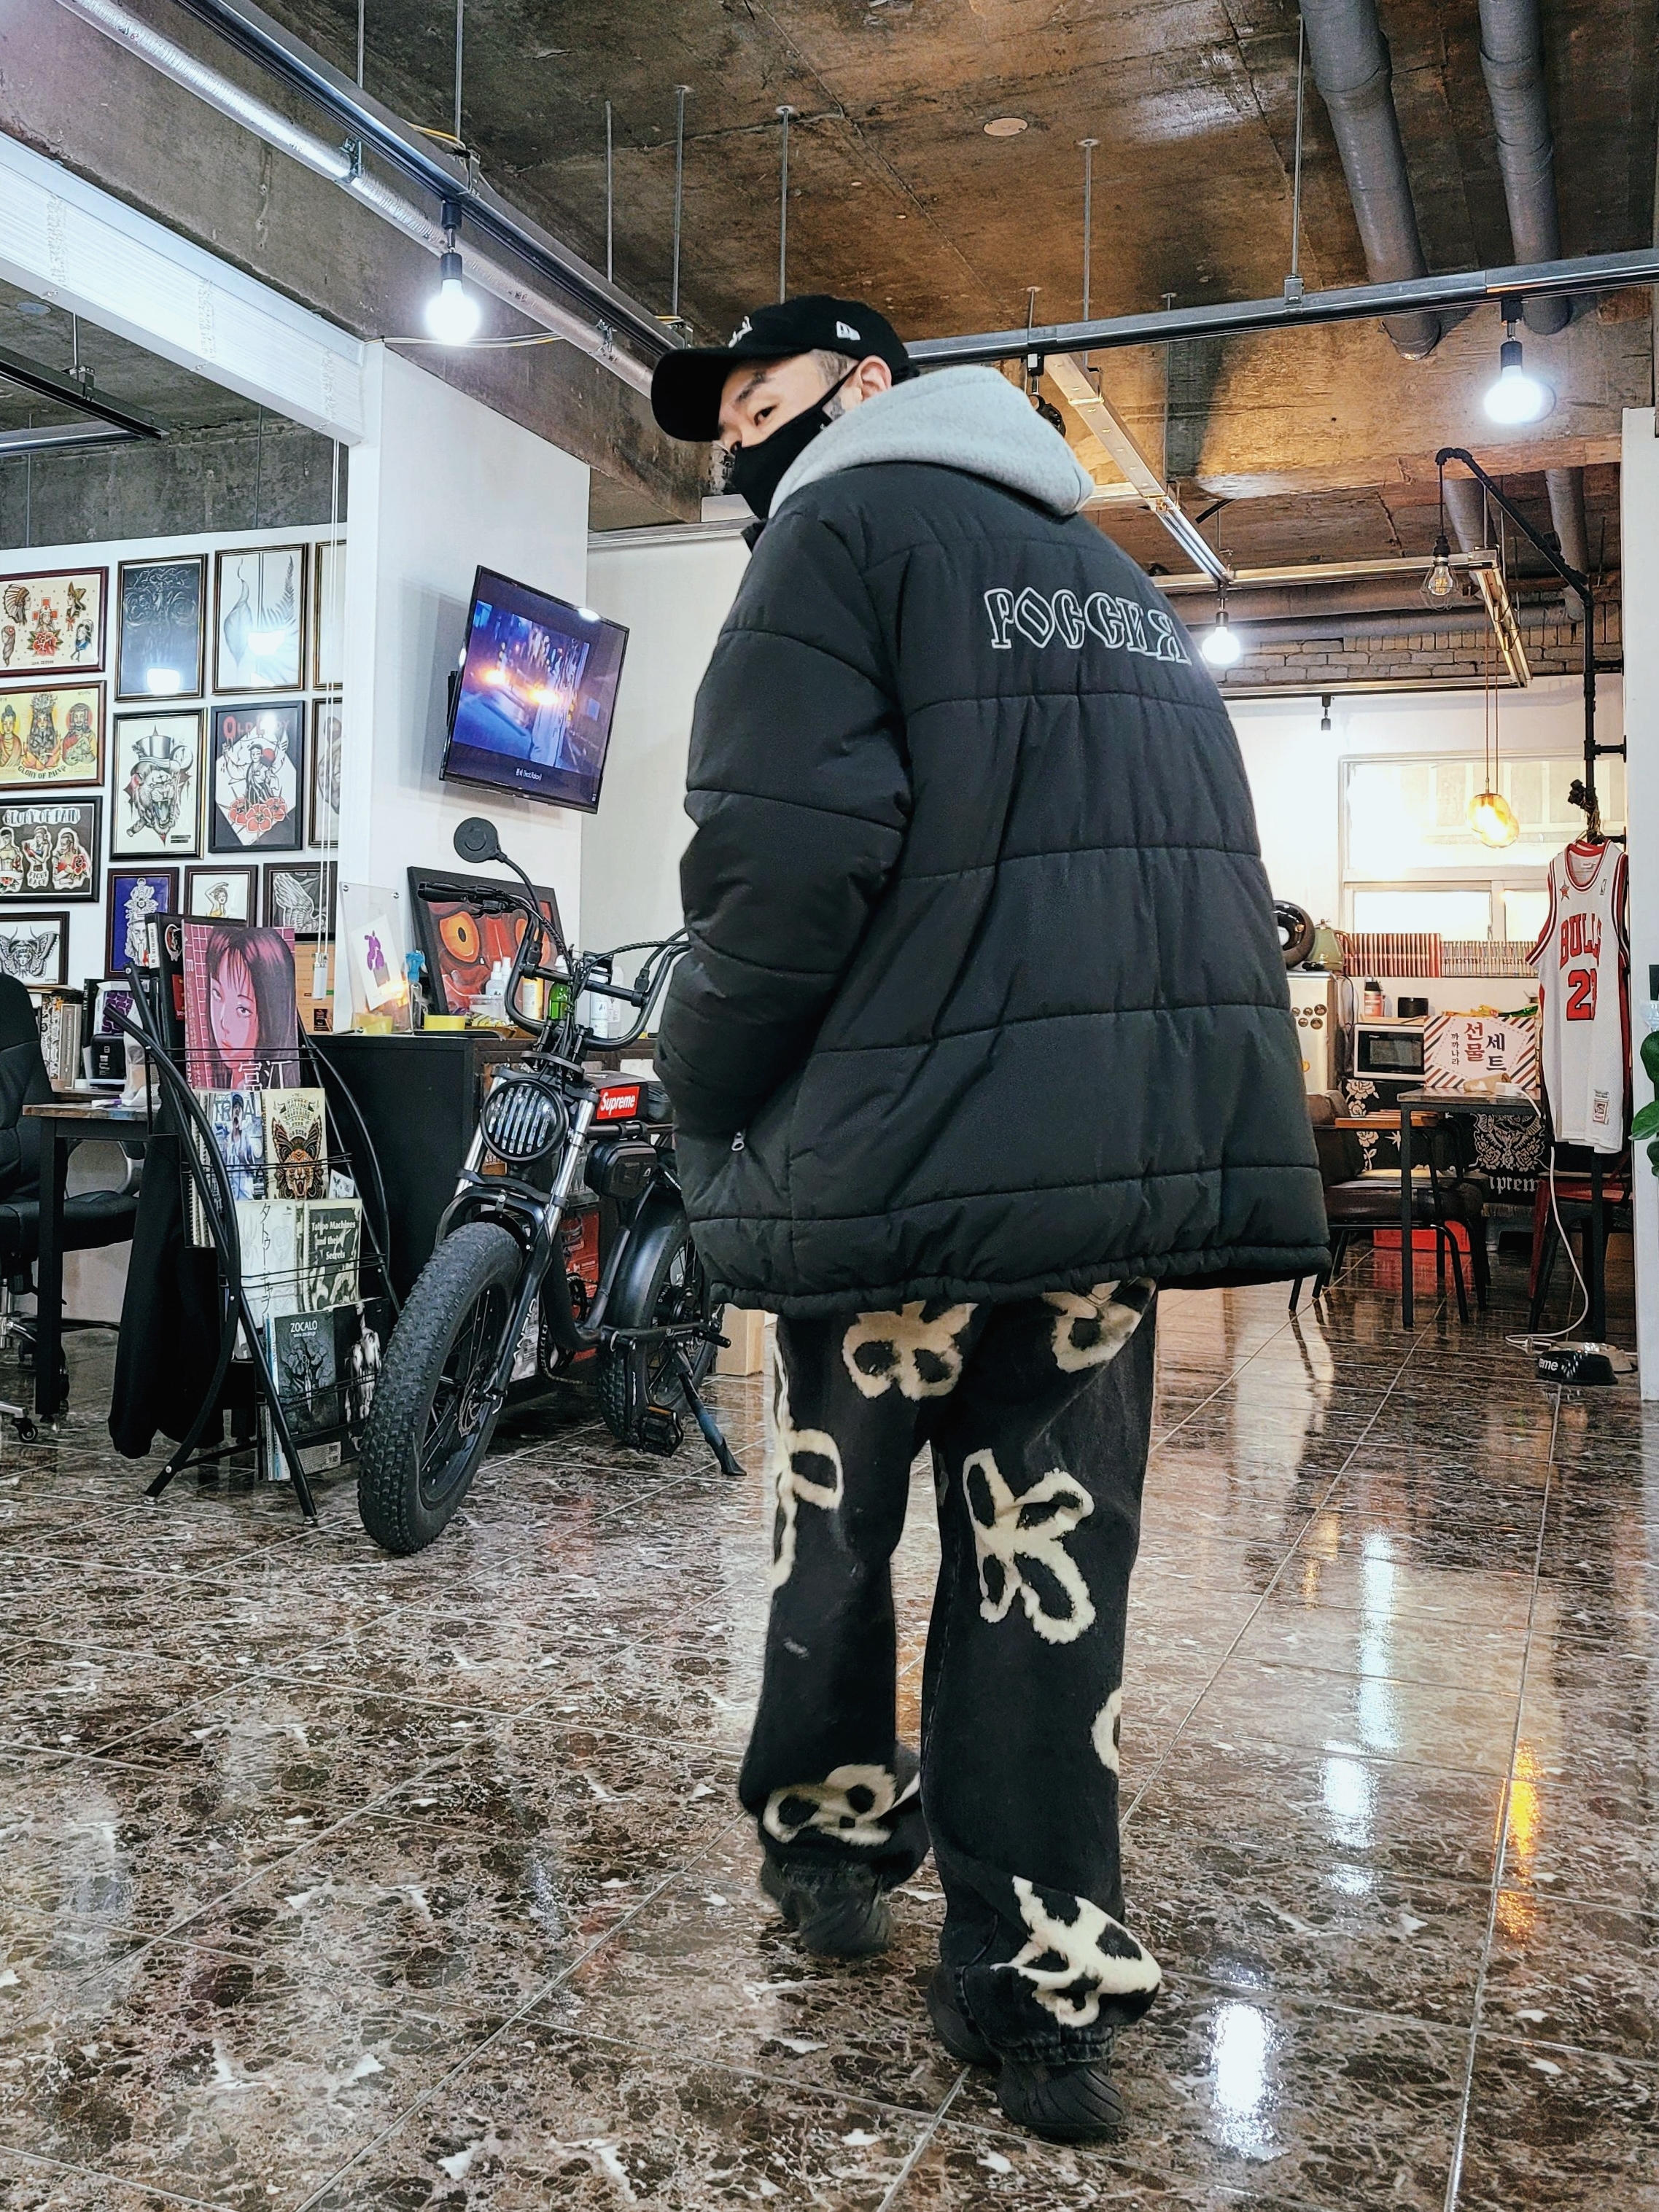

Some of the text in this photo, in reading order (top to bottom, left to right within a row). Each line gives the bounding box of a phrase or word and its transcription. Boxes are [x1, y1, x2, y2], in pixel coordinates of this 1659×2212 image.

[4, 809, 79, 824] GLORY OF PAIN
[1450, 1032, 1460, 1066] 까까나라
[1464, 1021, 1485, 1062] 선물
[1485, 1032, 1507, 1071] 세트
[600, 1091, 636, 1116] Supreme
[330, 1220, 356, 1230] Machines
[326, 1249, 346, 1260] Secrets
[290, 1320, 318, 1333] ZOCALO
